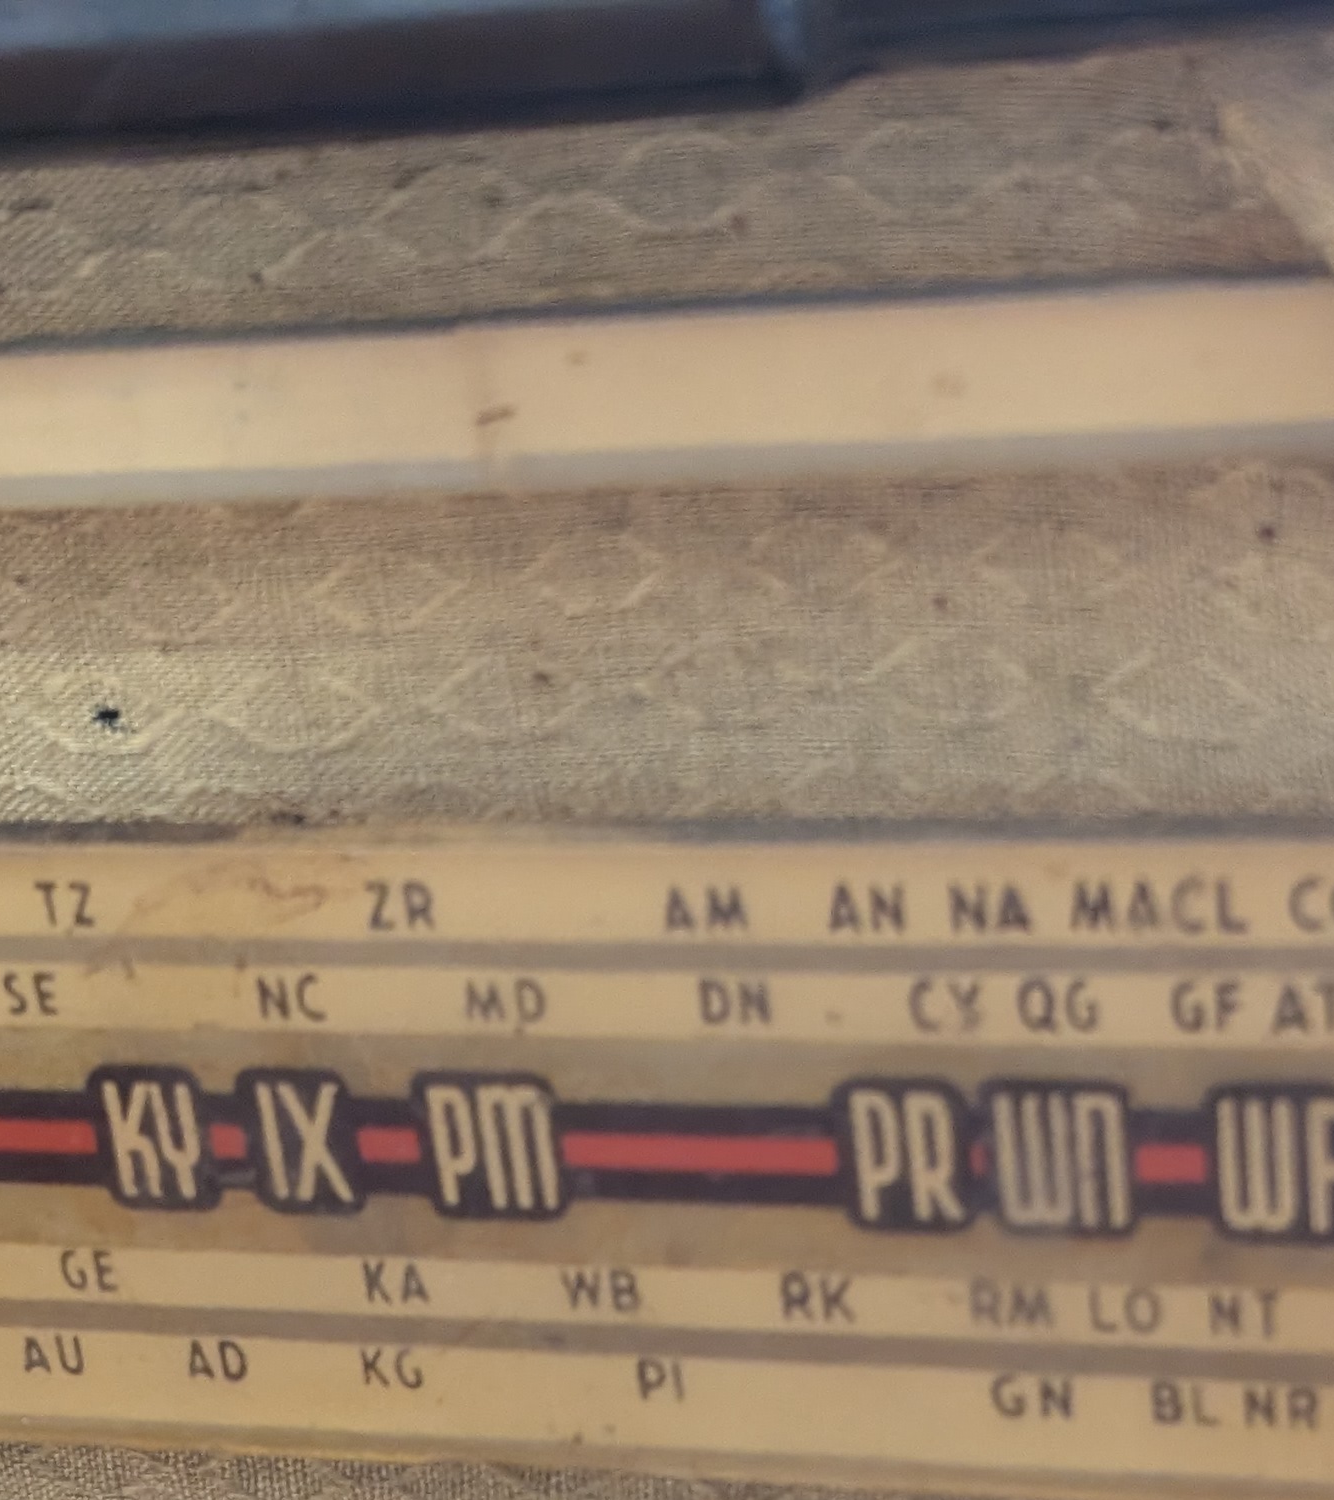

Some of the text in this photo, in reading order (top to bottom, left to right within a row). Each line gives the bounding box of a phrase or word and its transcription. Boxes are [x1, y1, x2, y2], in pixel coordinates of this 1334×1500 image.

[33, 880, 96, 929] TZ
[364, 880, 434, 932] ZR
[665, 884, 749, 932] AM
[828, 883, 906, 932] AN
[949, 885, 1032, 932] NA
[2, 971, 58, 1017] SE
[256, 973, 326, 1022] NC
[698, 978, 771, 1025] DN
[1016, 977, 1099, 1033] QG
[1170, 978, 1240, 1034] GF
[102, 1081, 201, 1199] KY
[255, 1081, 354, 1202] IX
[424, 1084, 560, 1210] PM
[848, 1088, 963, 1222] PR
[59, 1247, 118, 1293] GE
[361, 1257, 429, 1304] KA
[561, 1265, 641, 1313] WB
[780, 1265, 851, 1320] RK
[1088, 1288, 1162, 1335] LO
[23, 1333, 85, 1376] AU
[188, 1339, 248, 1383] AD
[360, 1345, 424, 1391] KG
[990, 1374, 1074, 1419] GN
[1151, 1381, 1221, 1427] BL
[1243, 1386, 1320, 1430] NR
